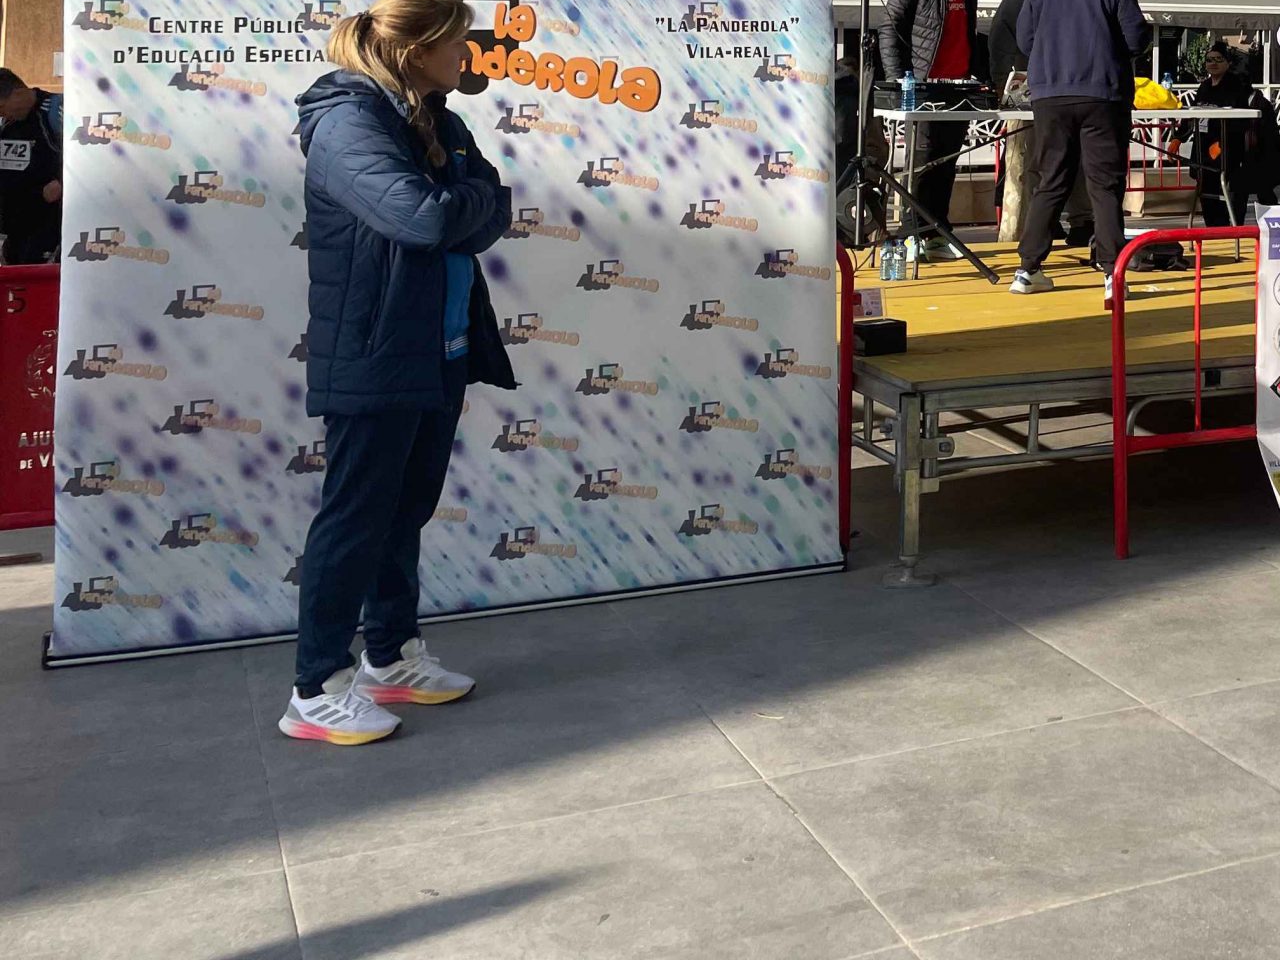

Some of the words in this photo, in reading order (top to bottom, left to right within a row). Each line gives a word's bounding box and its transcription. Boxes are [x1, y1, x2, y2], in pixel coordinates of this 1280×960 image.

[245, 48, 326, 63] ESPECIA
[4, 143, 27, 157] 742
[18, 431, 56, 447] AJU
